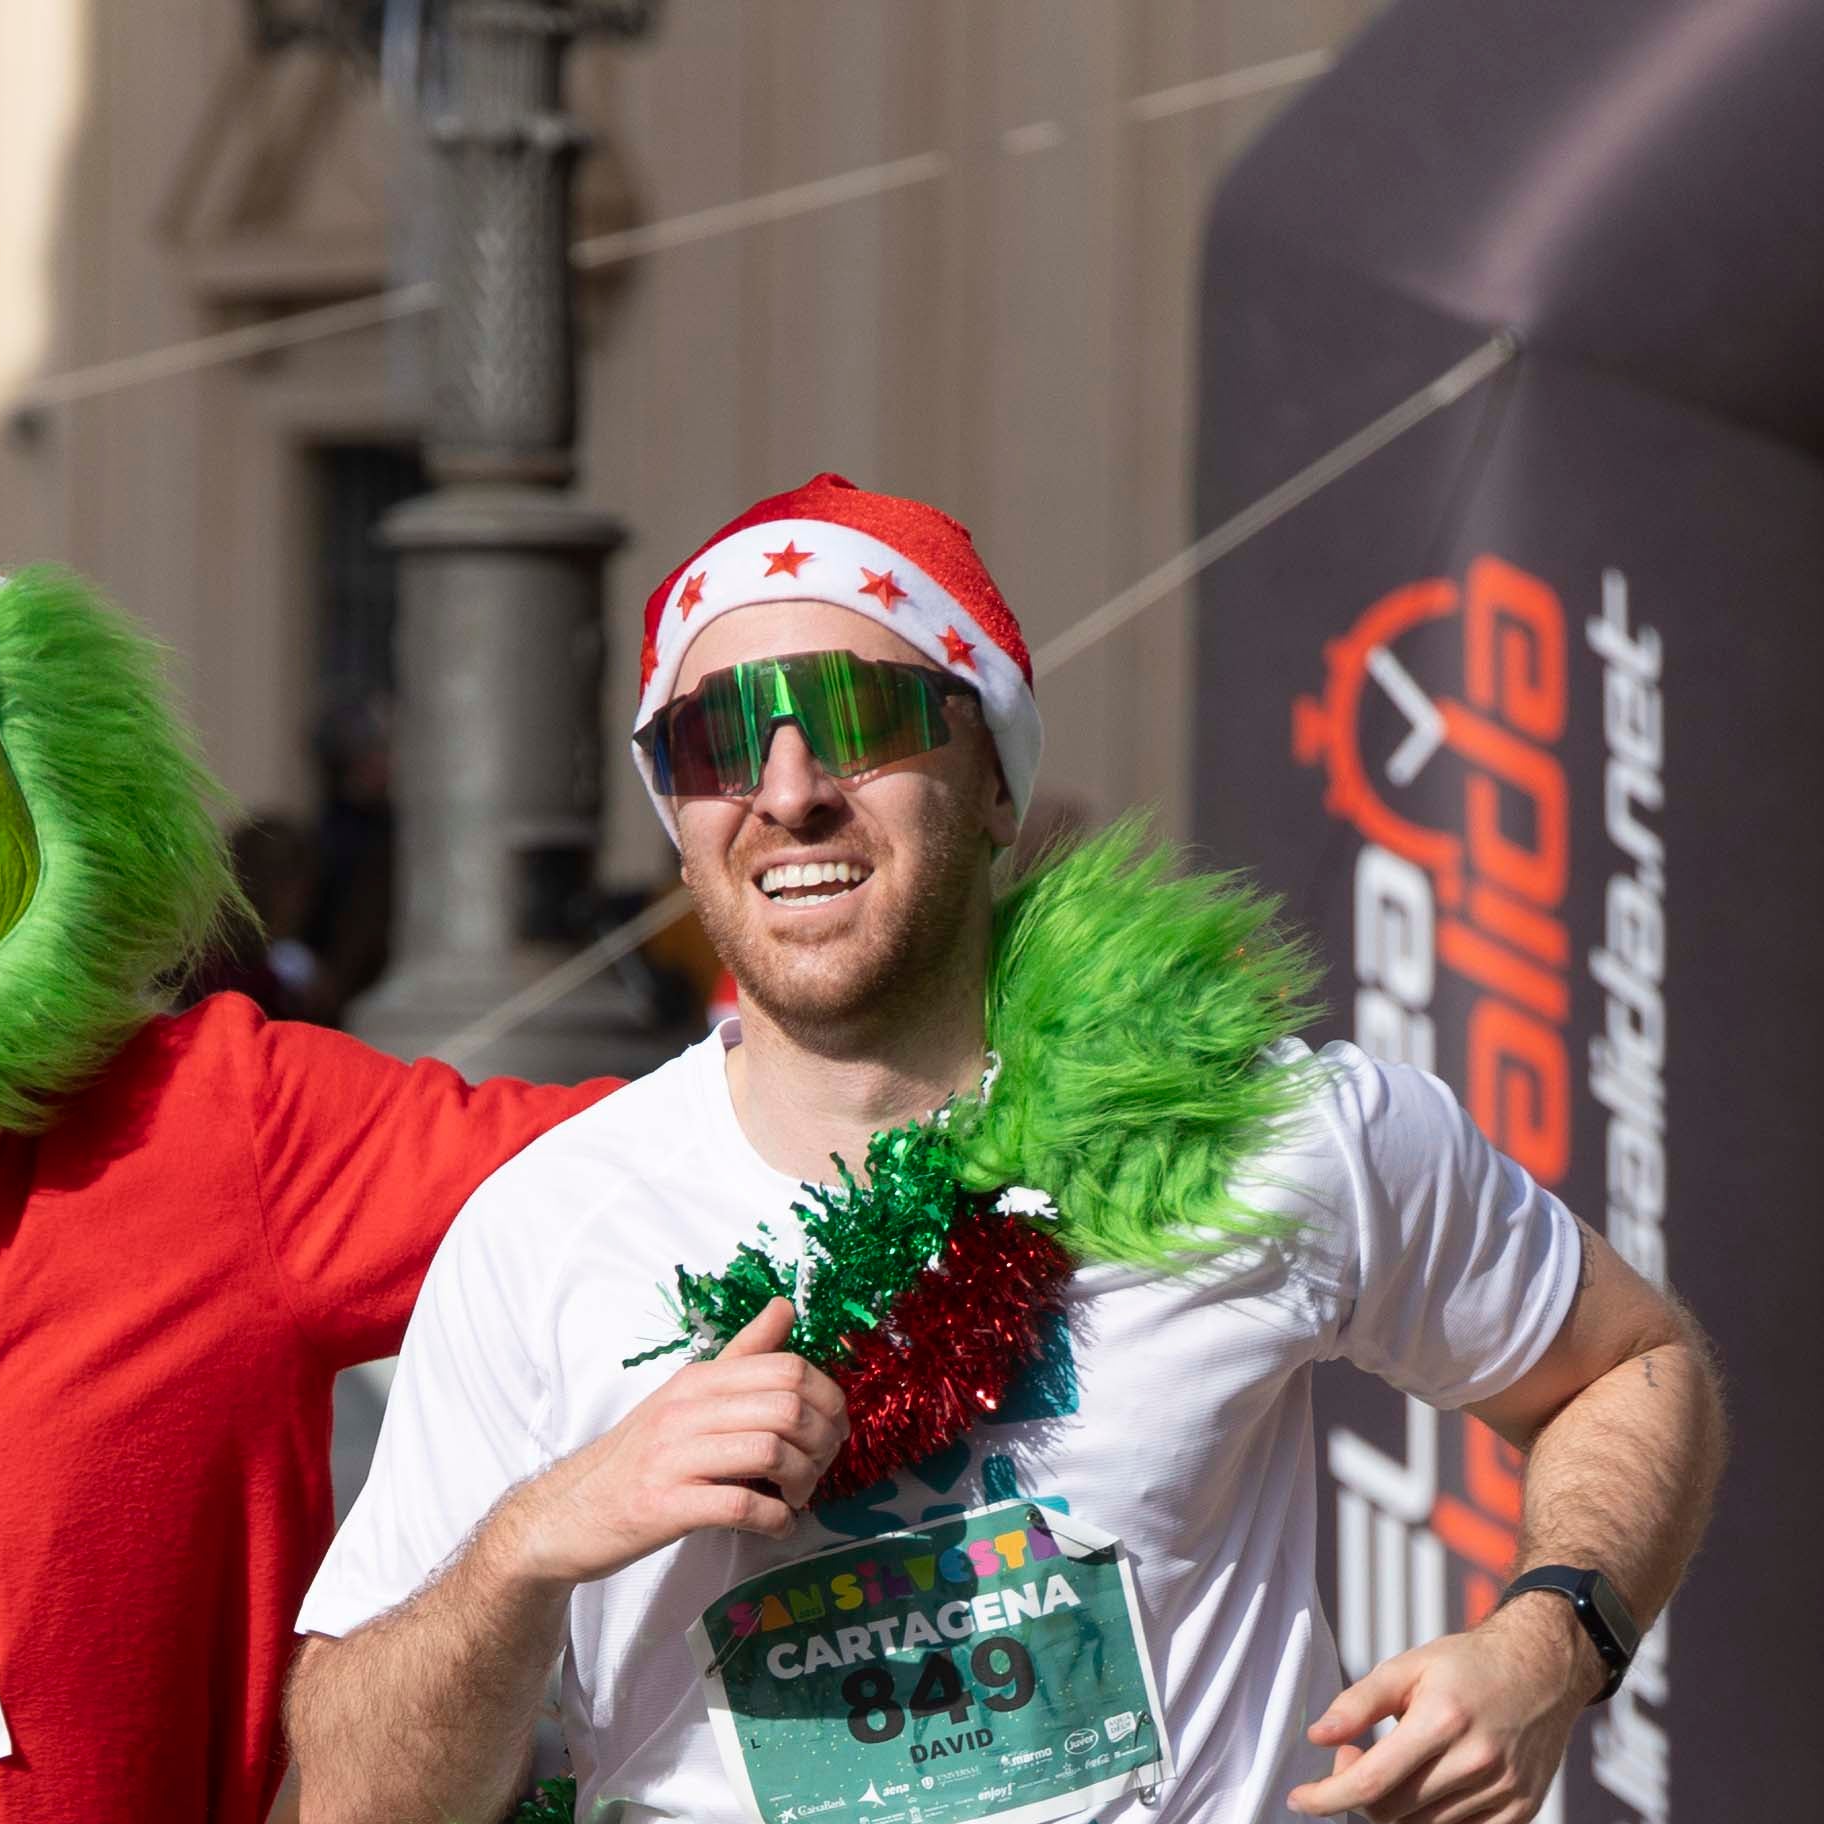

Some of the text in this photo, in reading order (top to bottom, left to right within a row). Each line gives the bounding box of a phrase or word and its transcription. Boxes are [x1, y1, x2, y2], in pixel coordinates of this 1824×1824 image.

[1438, 552, 1568, 1185] alida
[727, 1584, 825, 1637] SAN
[766, 1574, 1080, 1679] CARTAGENA
[841, 1636, 1036, 1744] 849
[910, 1728, 994, 1764] DAVID
